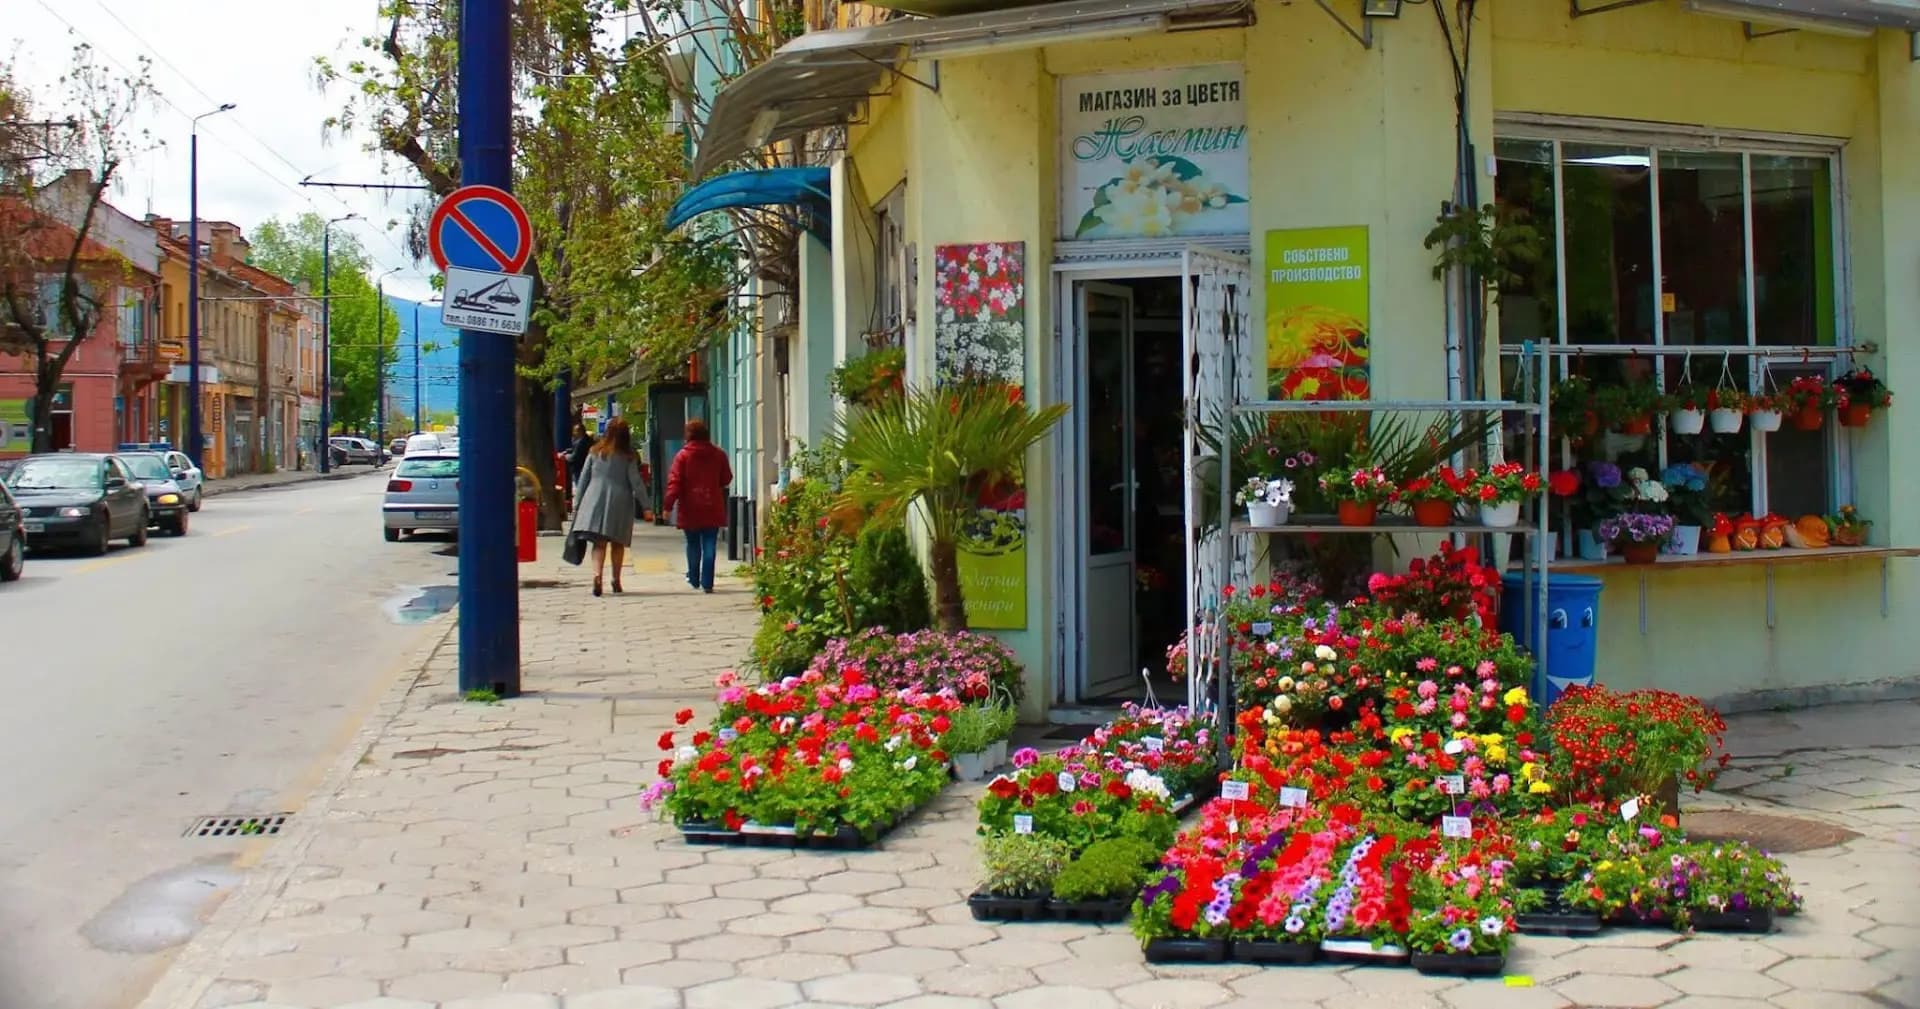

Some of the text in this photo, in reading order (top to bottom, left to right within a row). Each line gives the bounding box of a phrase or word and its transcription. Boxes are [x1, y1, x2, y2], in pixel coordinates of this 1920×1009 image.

[1079, 81, 1240, 112] МАГАЗИН за ЦВЕТЯ
[1284, 248, 1347, 263] СОБСТВЕНО
[1271, 266, 1360, 282] ПРОИЗВОДСТВО
